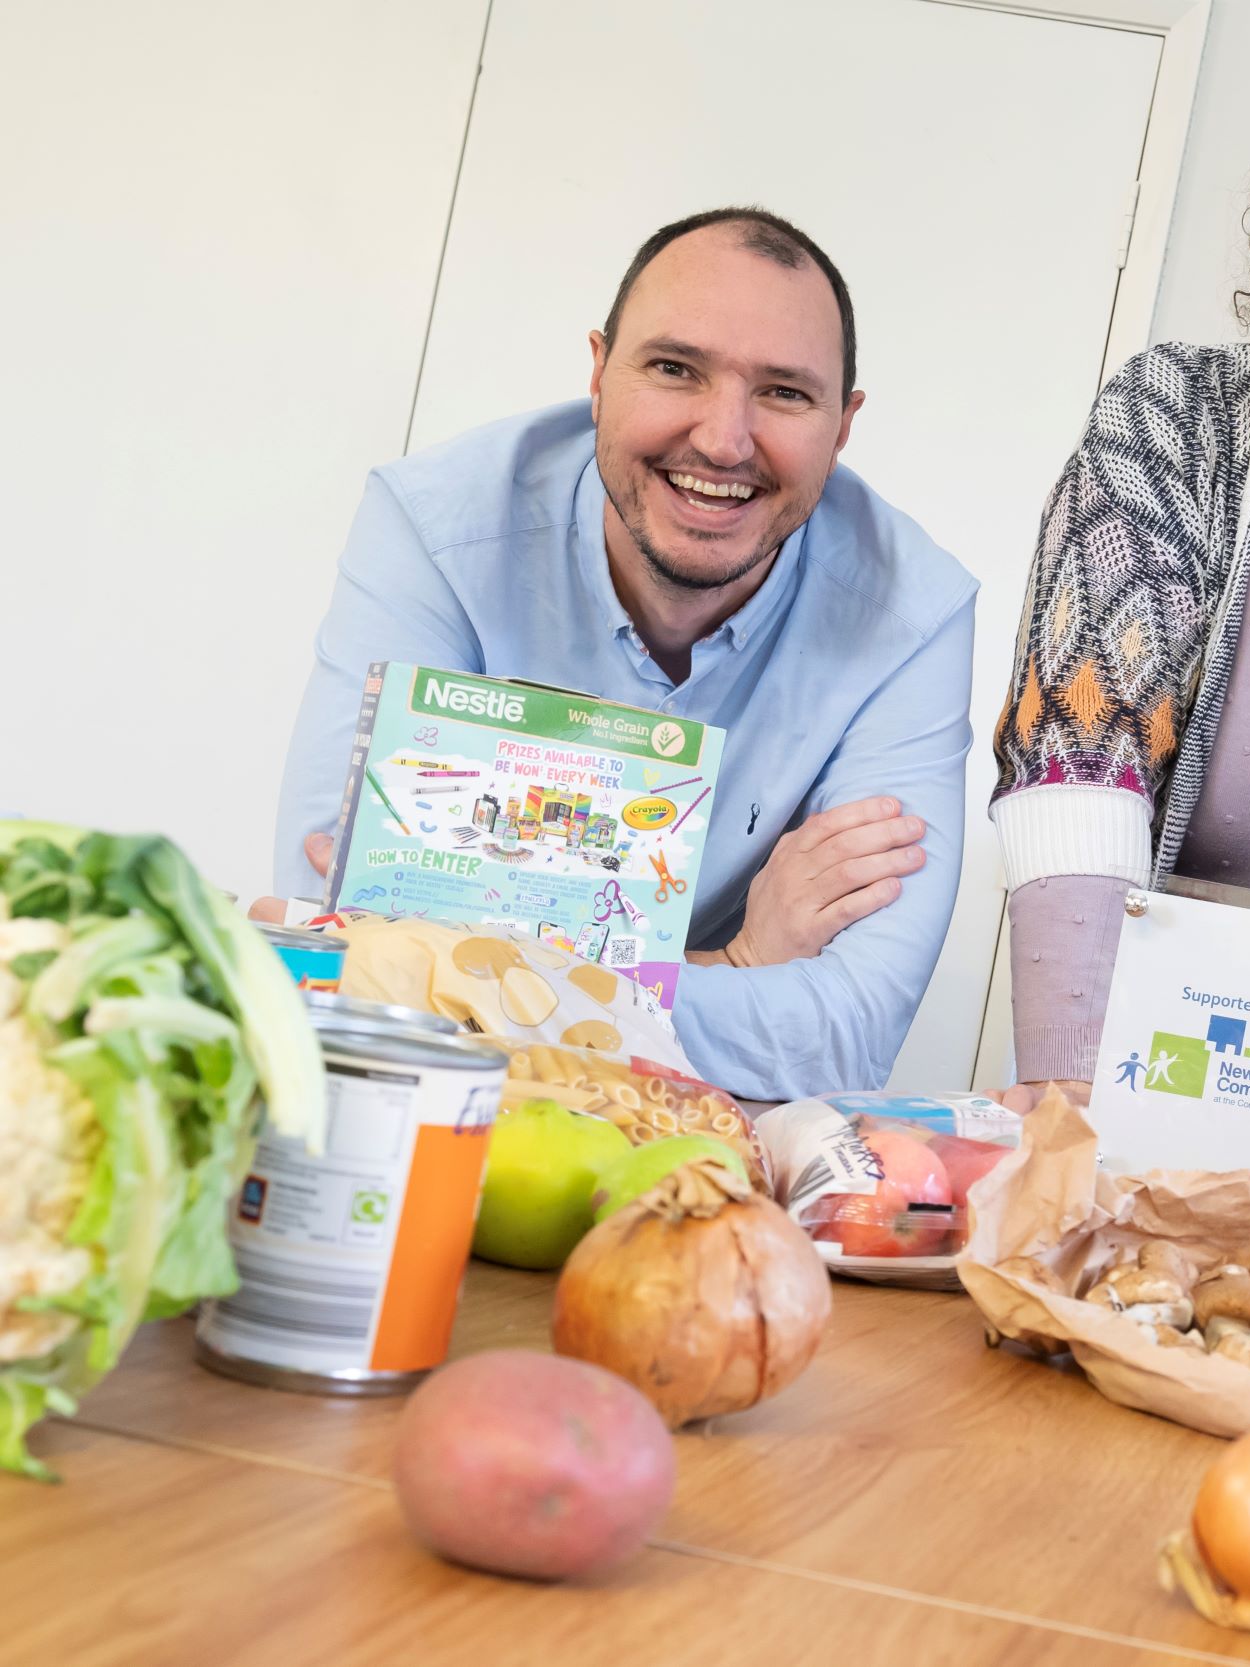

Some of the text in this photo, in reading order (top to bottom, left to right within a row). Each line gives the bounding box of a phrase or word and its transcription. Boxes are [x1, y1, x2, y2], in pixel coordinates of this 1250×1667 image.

[568, 709, 650, 736] Whole Grain
[498, 741, 623, 772] PRIZES AVAILABLE TO
[495, 760, 511, 773] BE
[546, 767, 587, 783] EVERY
[590, 774, 620, 789] WEEK
[632, 805, 667, 814] Crayola
[368, 848, 482, 876] HOW TO ENTER
[1223, 1097, 1236, 1106] the
